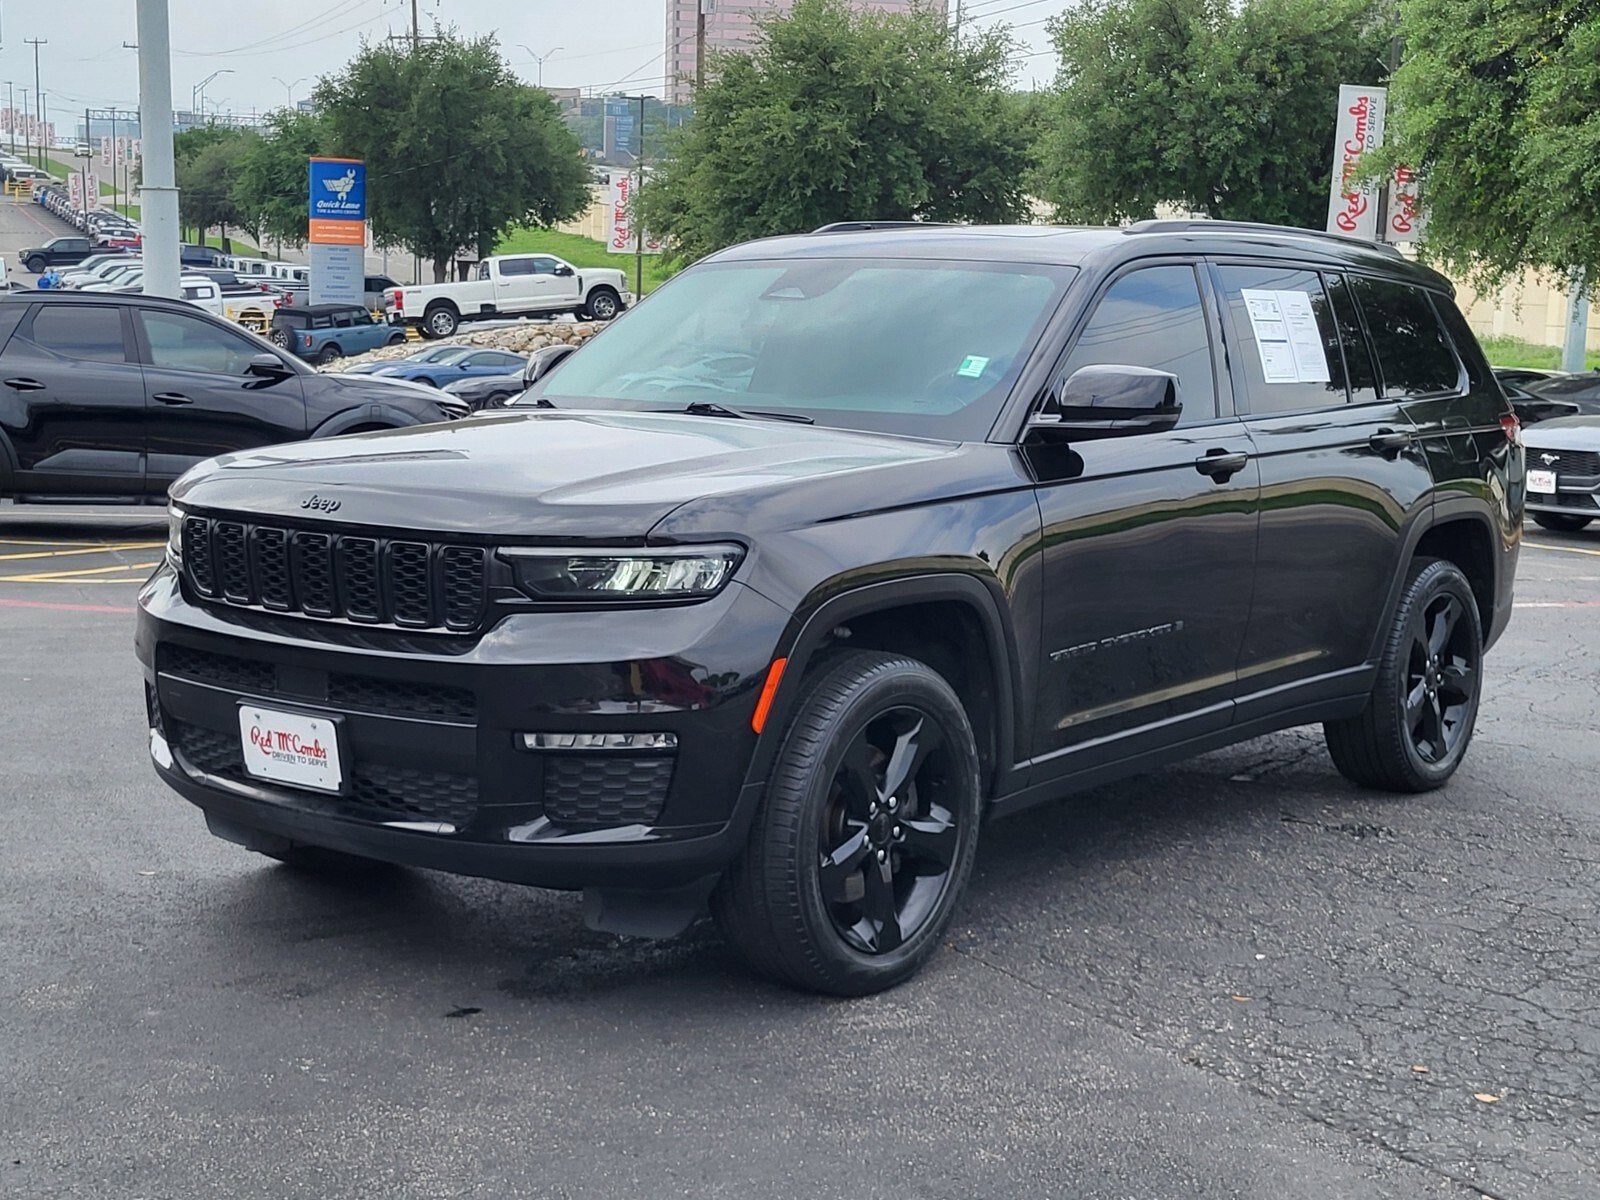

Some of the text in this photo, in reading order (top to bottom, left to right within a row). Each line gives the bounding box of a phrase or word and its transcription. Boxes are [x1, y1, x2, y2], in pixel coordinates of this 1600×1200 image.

[1366, 97, 1378, 150] TO SERVE
[316, 200, 361, 210] Quick Lane
[1337, 191, 1368, 232] Red
[613, 227, 630, 249] Red
[300, 494, 342, 514] Jeep
[250, 725, 327, 759] Red McCombs
[272, 751, 296, 762] DRIVEN
[297, 756, 307, 765] TO
[308, 758, 328, 768] SERVE
